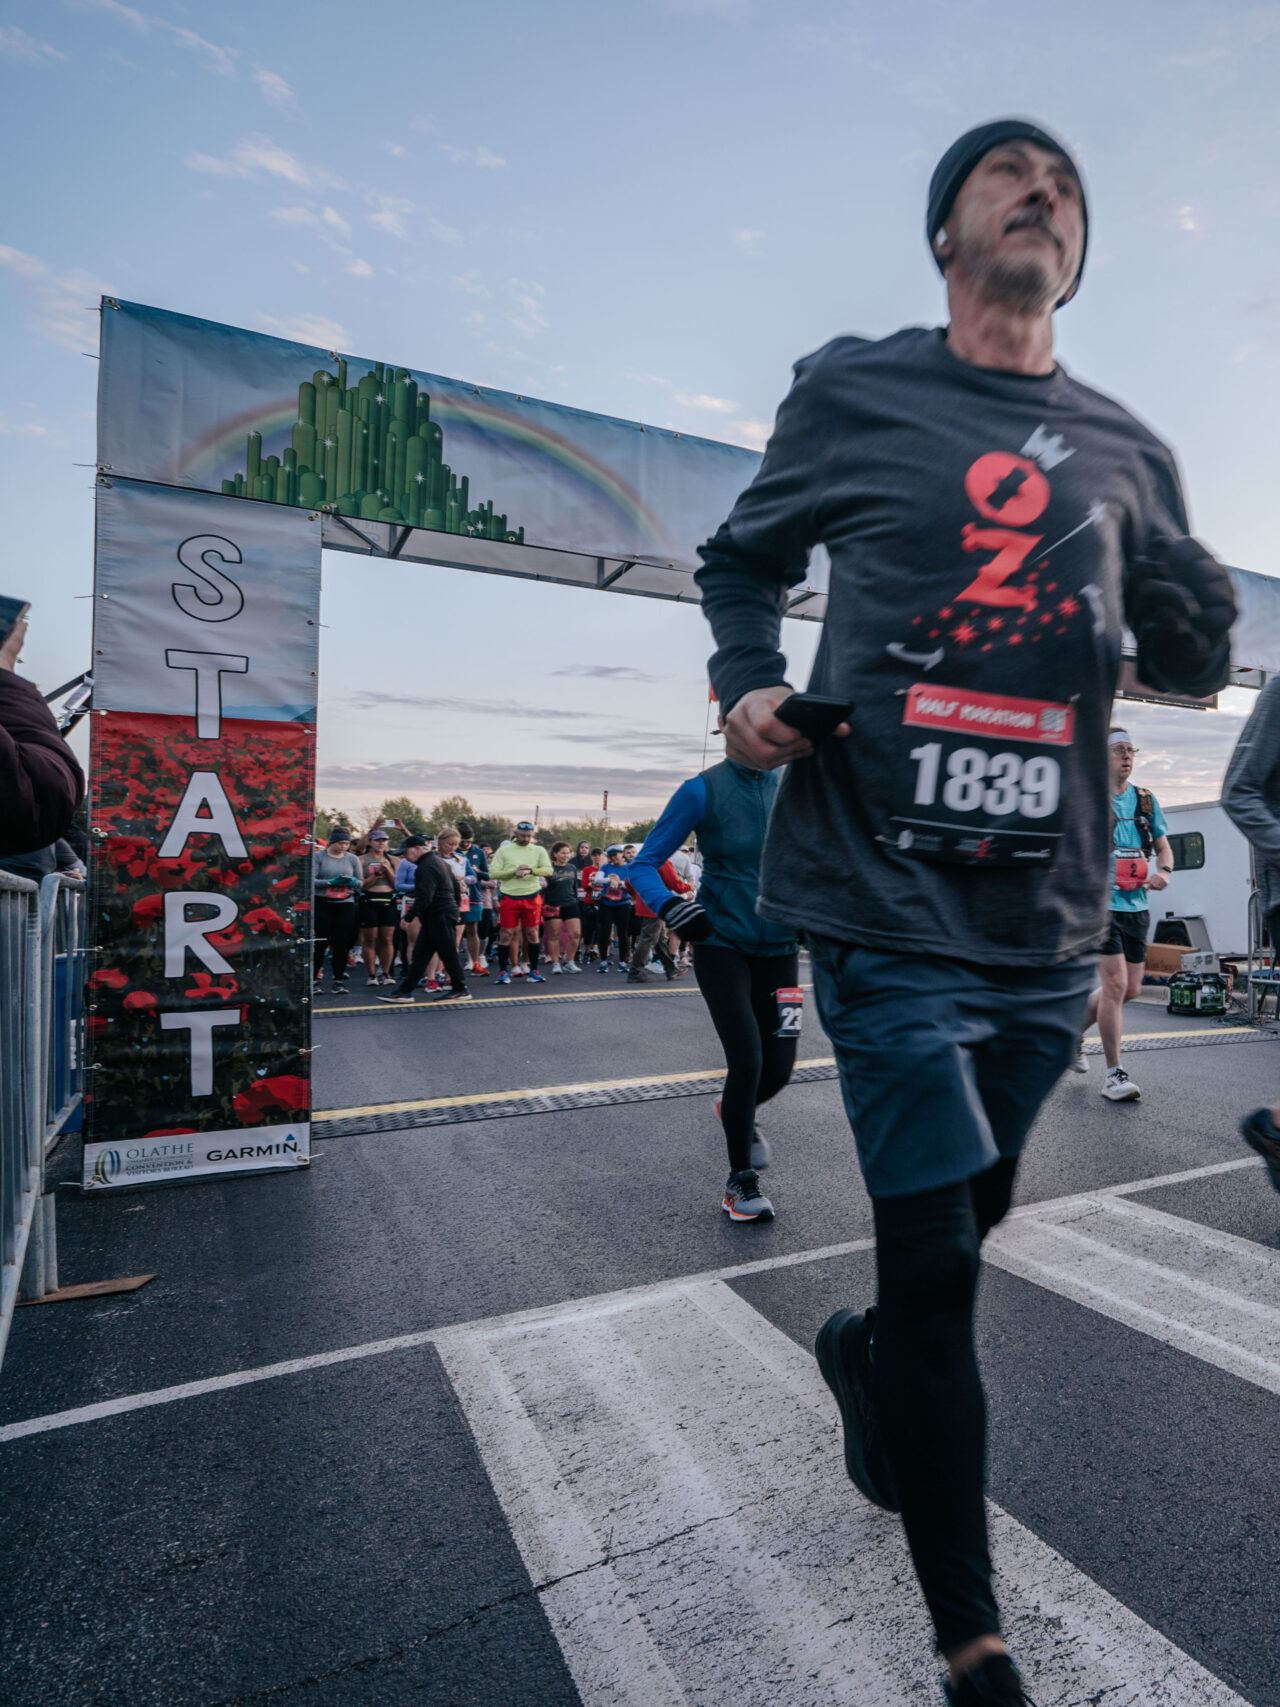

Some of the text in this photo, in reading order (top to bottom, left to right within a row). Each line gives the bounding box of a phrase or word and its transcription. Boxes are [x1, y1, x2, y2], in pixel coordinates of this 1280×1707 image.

[909, 742, 1061, 819] 1839
[157, 534, 249, 1097] START
[126, 1143, 194, 1160] OLATHE
[206, 1142, 298, 1162] GARMIN
[126, 1160, 184, 1171] CONVENTION
